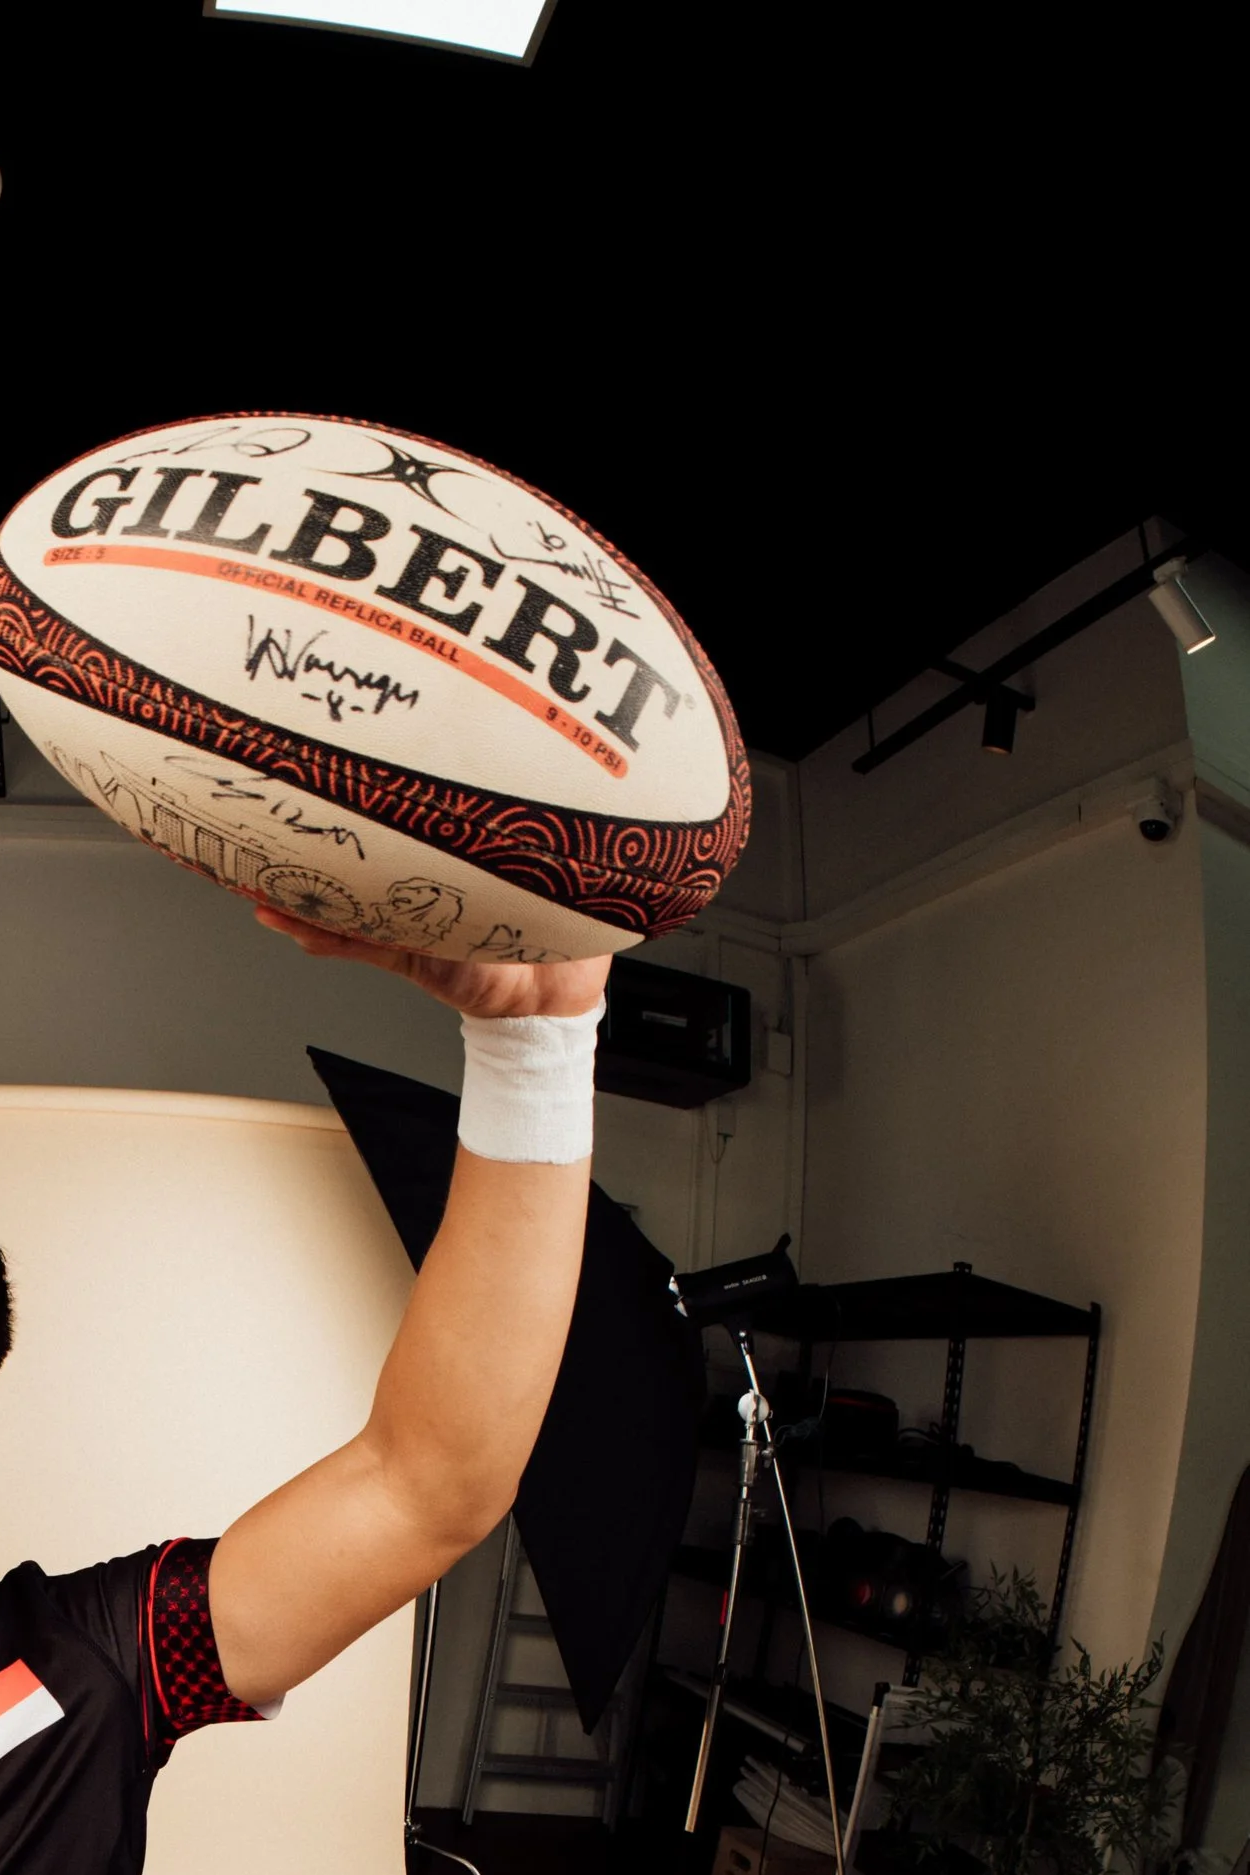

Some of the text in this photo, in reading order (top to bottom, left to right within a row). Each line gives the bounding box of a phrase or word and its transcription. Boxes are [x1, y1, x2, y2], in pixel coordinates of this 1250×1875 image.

[50, 547, 85, 562] SIZE
[50, 466, 681, 753] GILBERT
[216, 561, 461, 664] OFFICIAL REPLICA BALL
[545, 706, 559, 721] 9
[572, 726, 592, 747] 10
[594, 742, 623, 771] PSI
